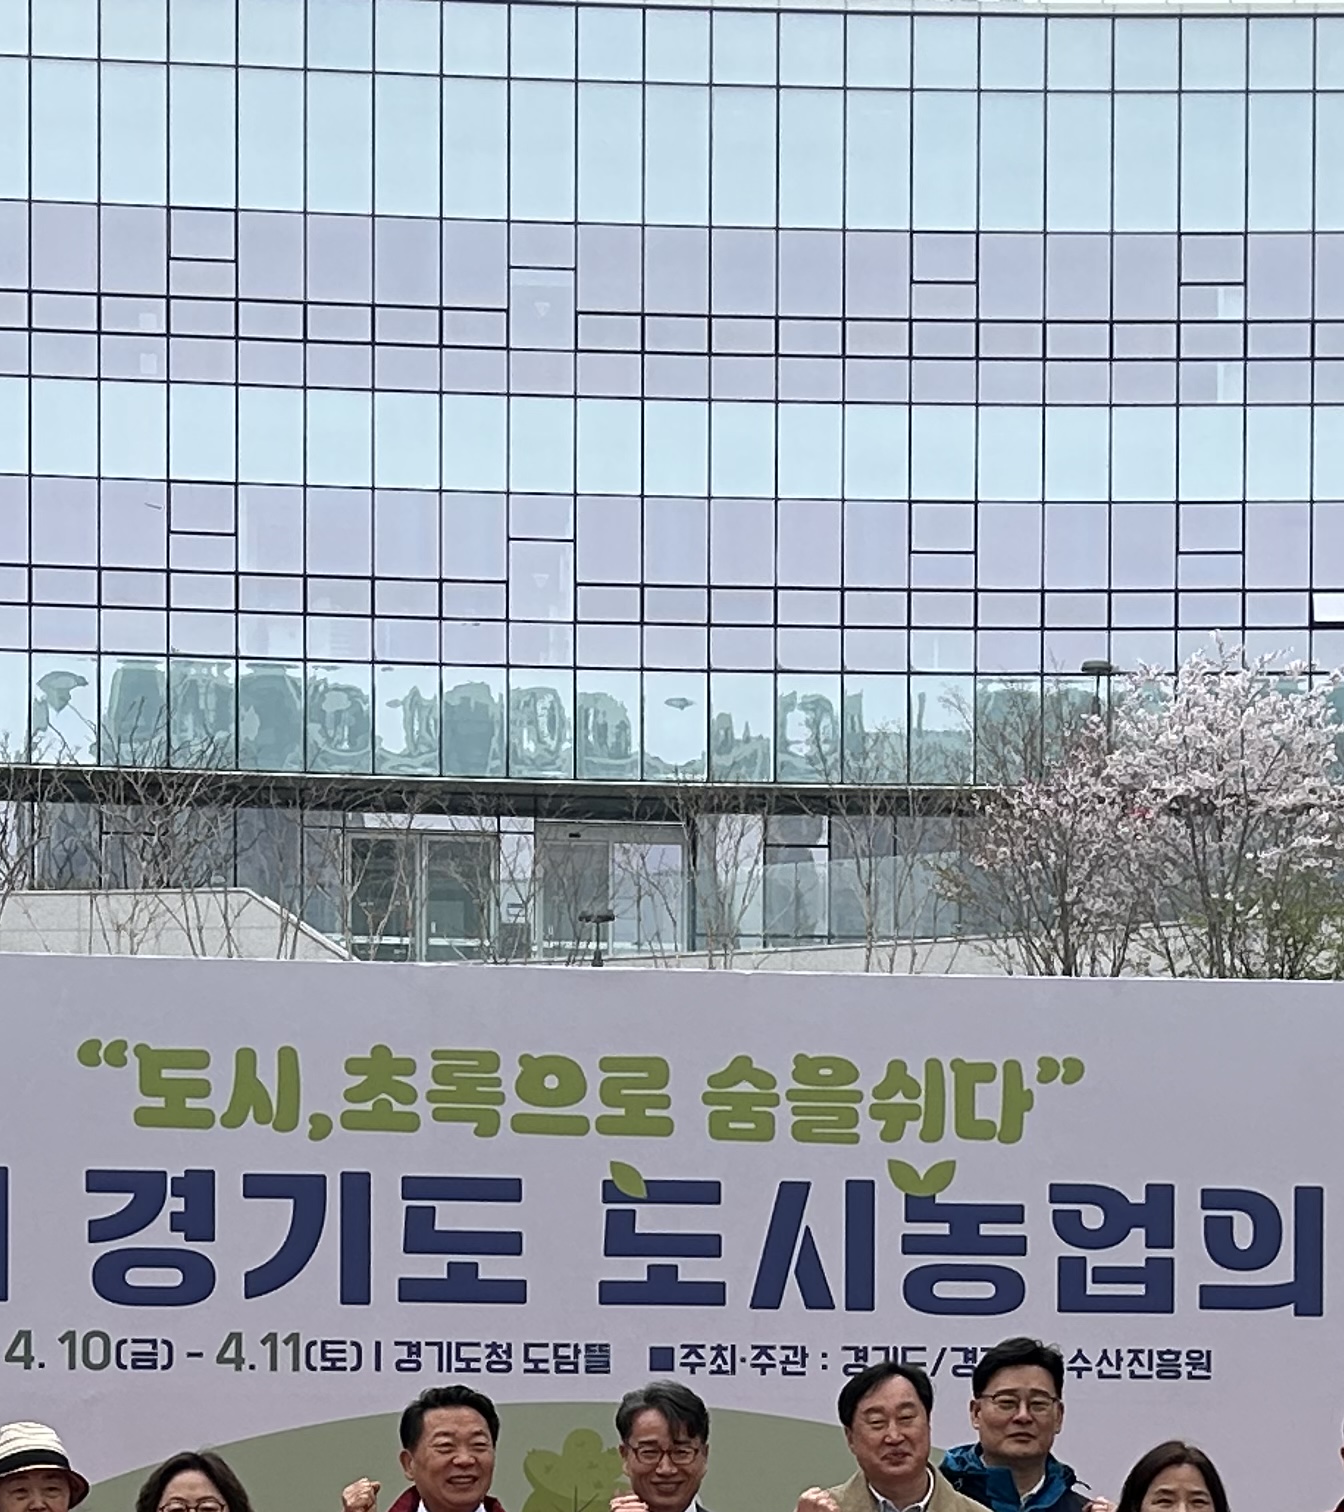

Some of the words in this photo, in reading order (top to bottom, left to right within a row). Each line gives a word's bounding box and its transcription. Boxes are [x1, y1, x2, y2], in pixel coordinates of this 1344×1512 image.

[85, 1168, 527, 1307] 경기도
[598, 1176, 1324, 1317] 도시농업의
[57, 1329, 174, 1370] 10(금)
[215, 1331, 363, 1373] 4.11(토)
[393, 1340, 513, 1374] 경기도청
[522, 1342, 612, 1375] 도담뜰
